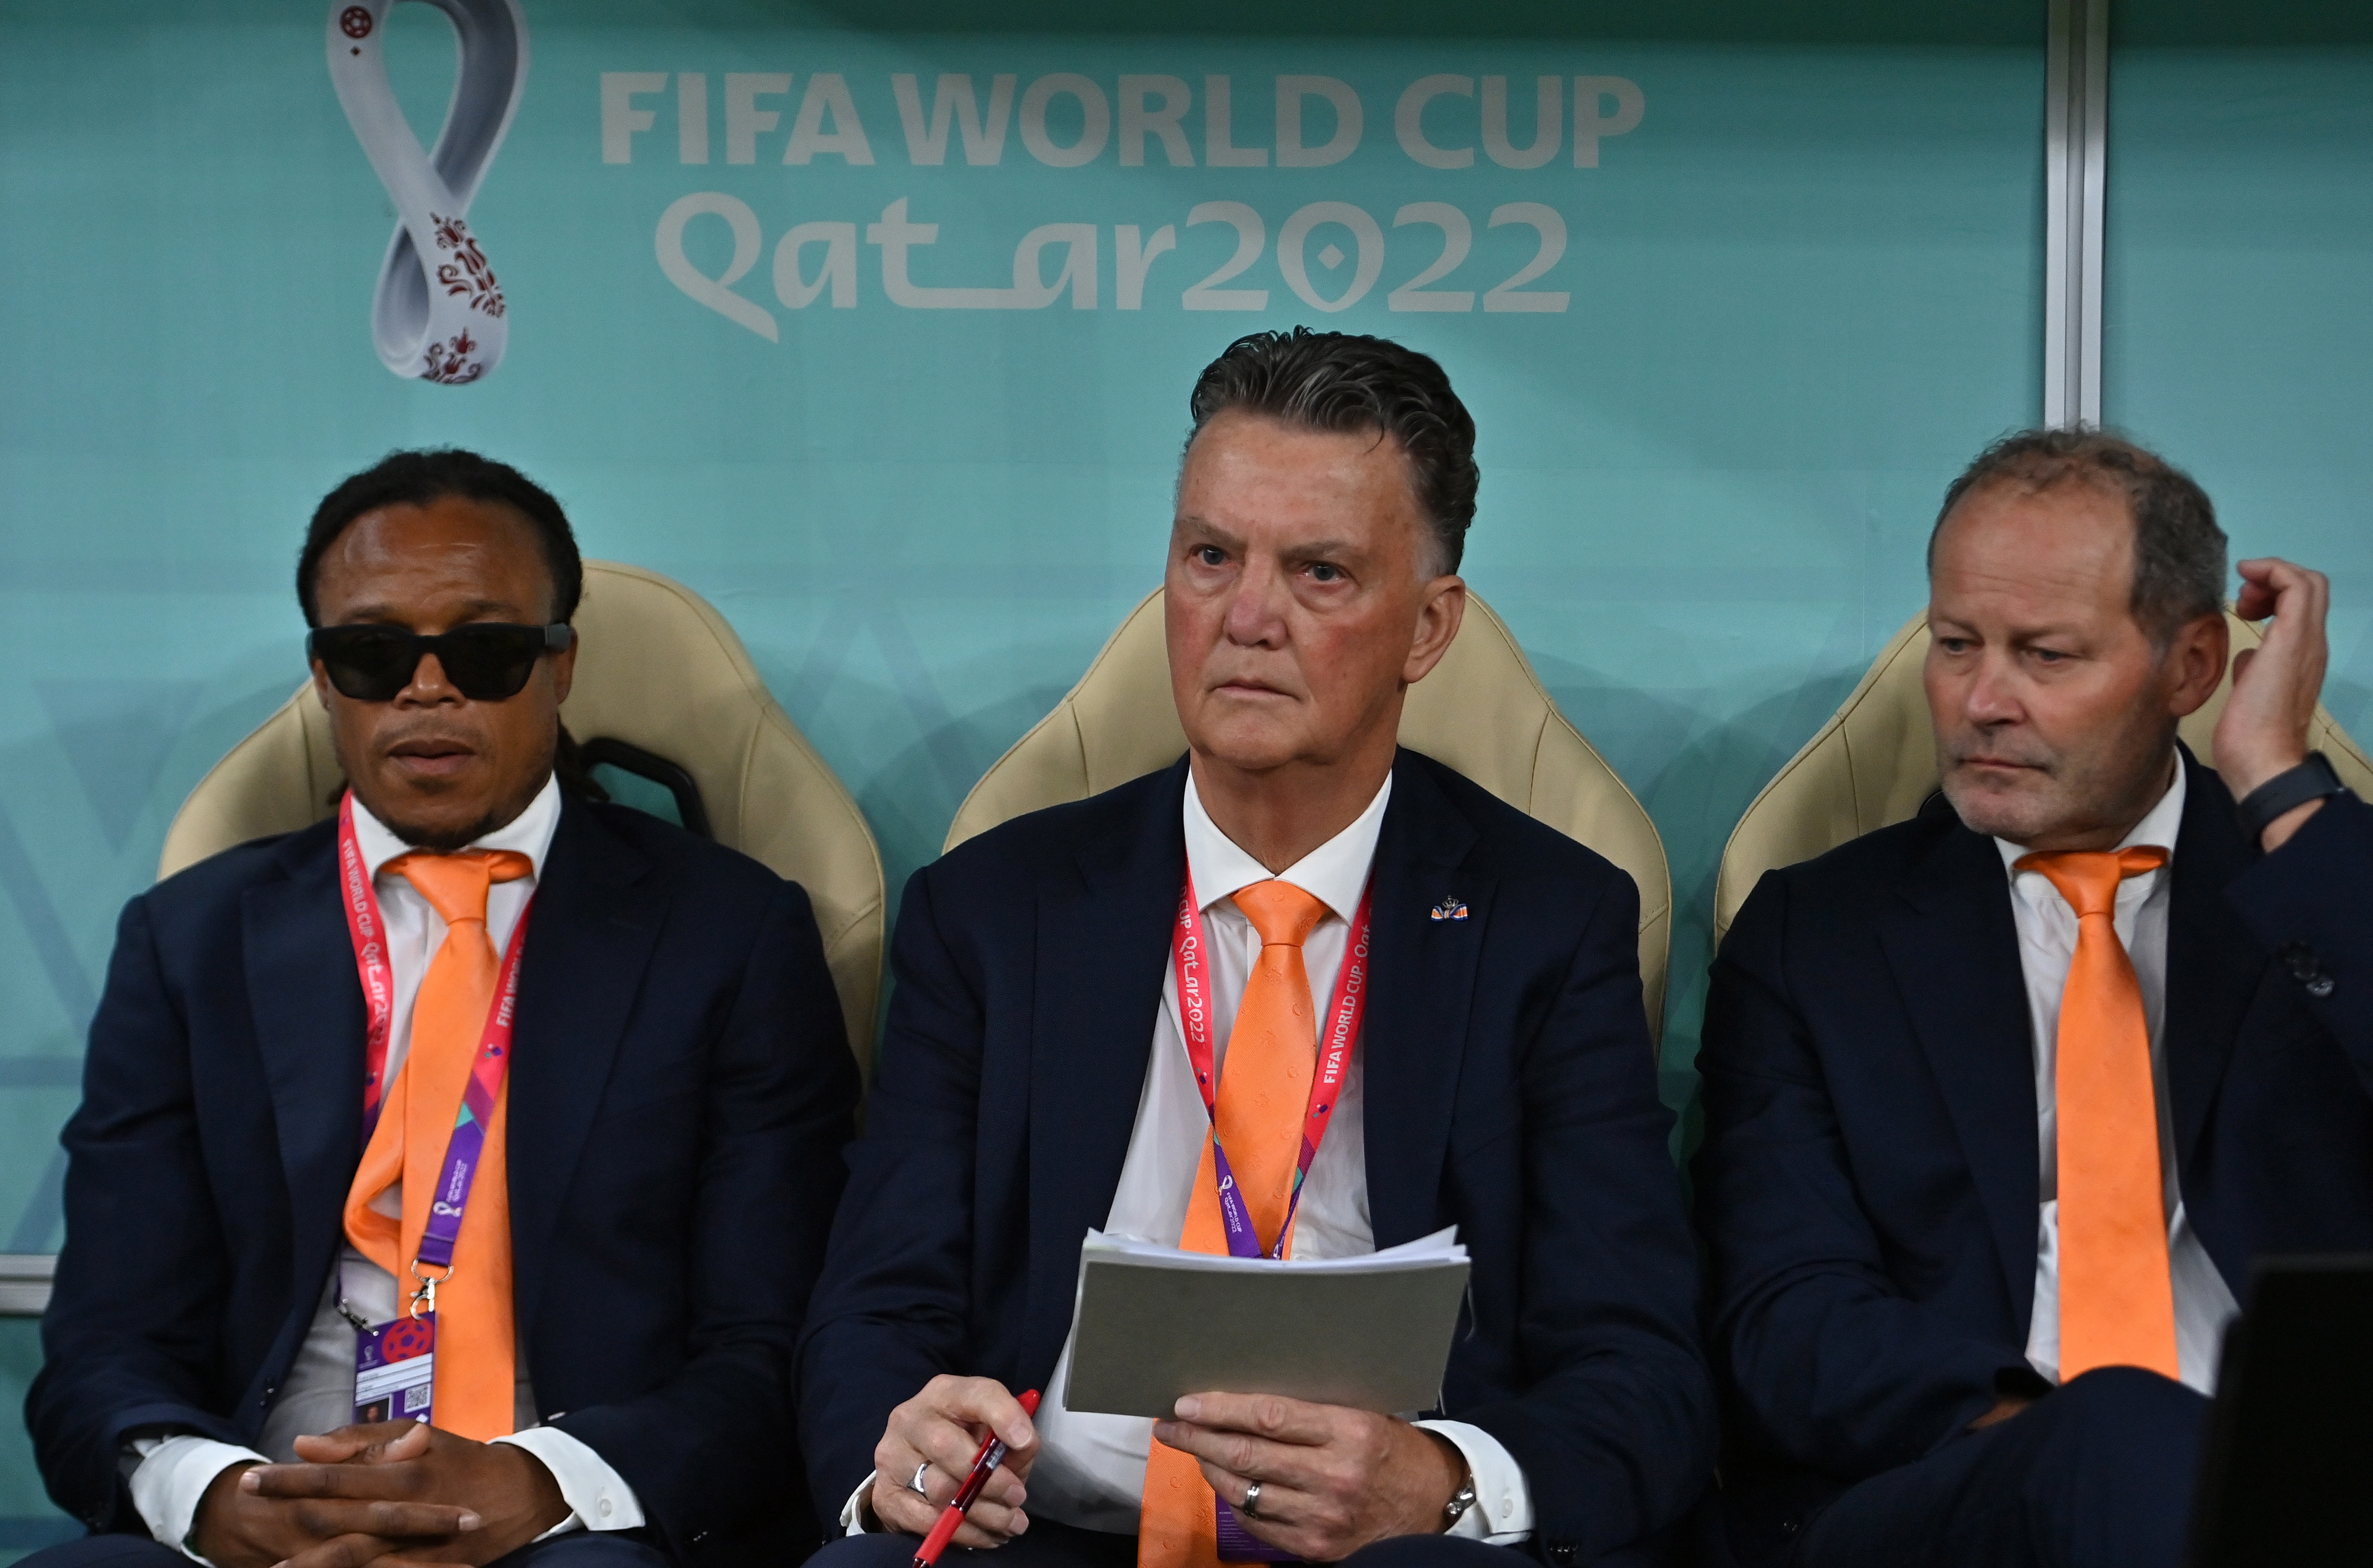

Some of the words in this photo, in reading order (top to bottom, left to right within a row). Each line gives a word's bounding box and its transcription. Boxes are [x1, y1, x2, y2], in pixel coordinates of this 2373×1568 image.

[600, 72, 876, 166] FIFA
[891, 72, 1364, 168] WORLD
[1394, 73, 1645, 170] CUP
[655, 191, 1570, 343] Qatar2022
[349, 865, 368, 913] WORLD
[357, 913, 375, 937] CUP
[1179, 899, 1192, 929] CUP
[1179, 936, 1205, 1043] Qatar2022
[1347, 965, 1363, 993] CUP
[495, 996, 516, 1027] FIFA
[1331, 995, 1356, 1049] WORLD
[1323, 1051, 1342, 1083] FIFA
[1231, 1203, 1239, 1222] WORLD
